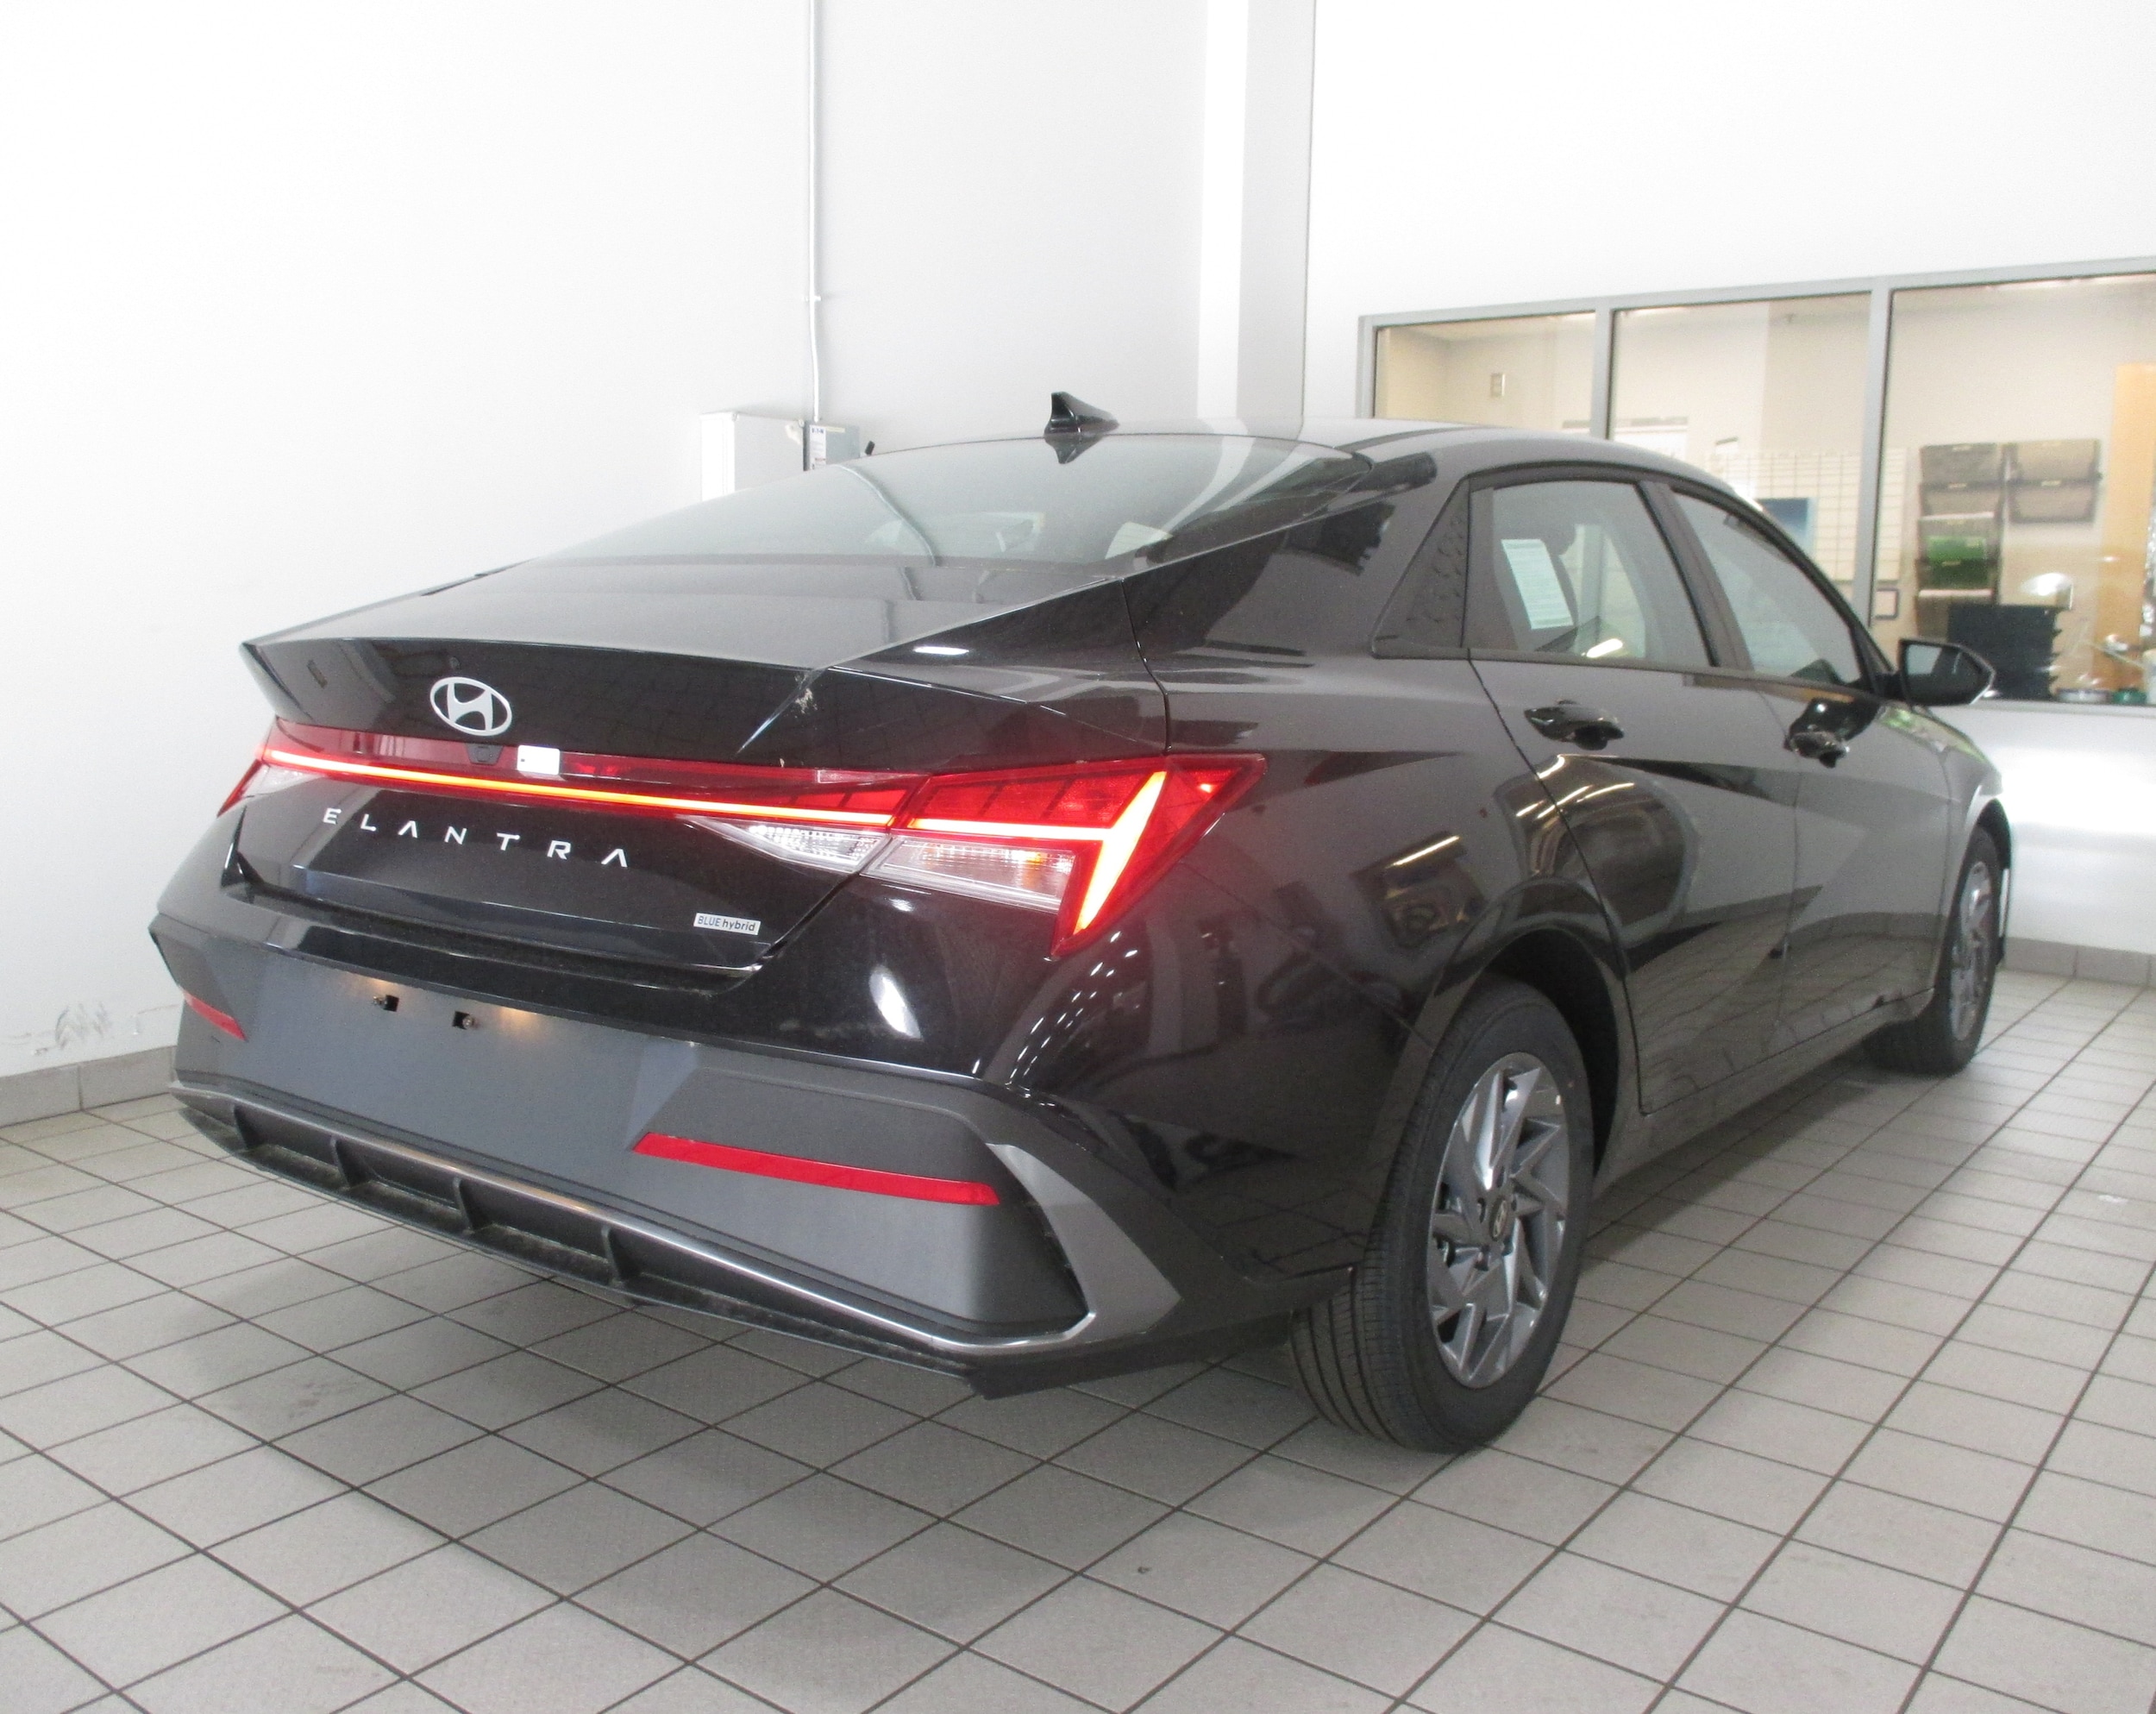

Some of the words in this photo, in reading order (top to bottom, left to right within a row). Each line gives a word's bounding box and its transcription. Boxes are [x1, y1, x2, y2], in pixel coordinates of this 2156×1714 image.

[323, 808, 628, 868] ELANTRA
[698, 915, 722, 926] BLUE
[723, 919, 755, 931] hybrid
